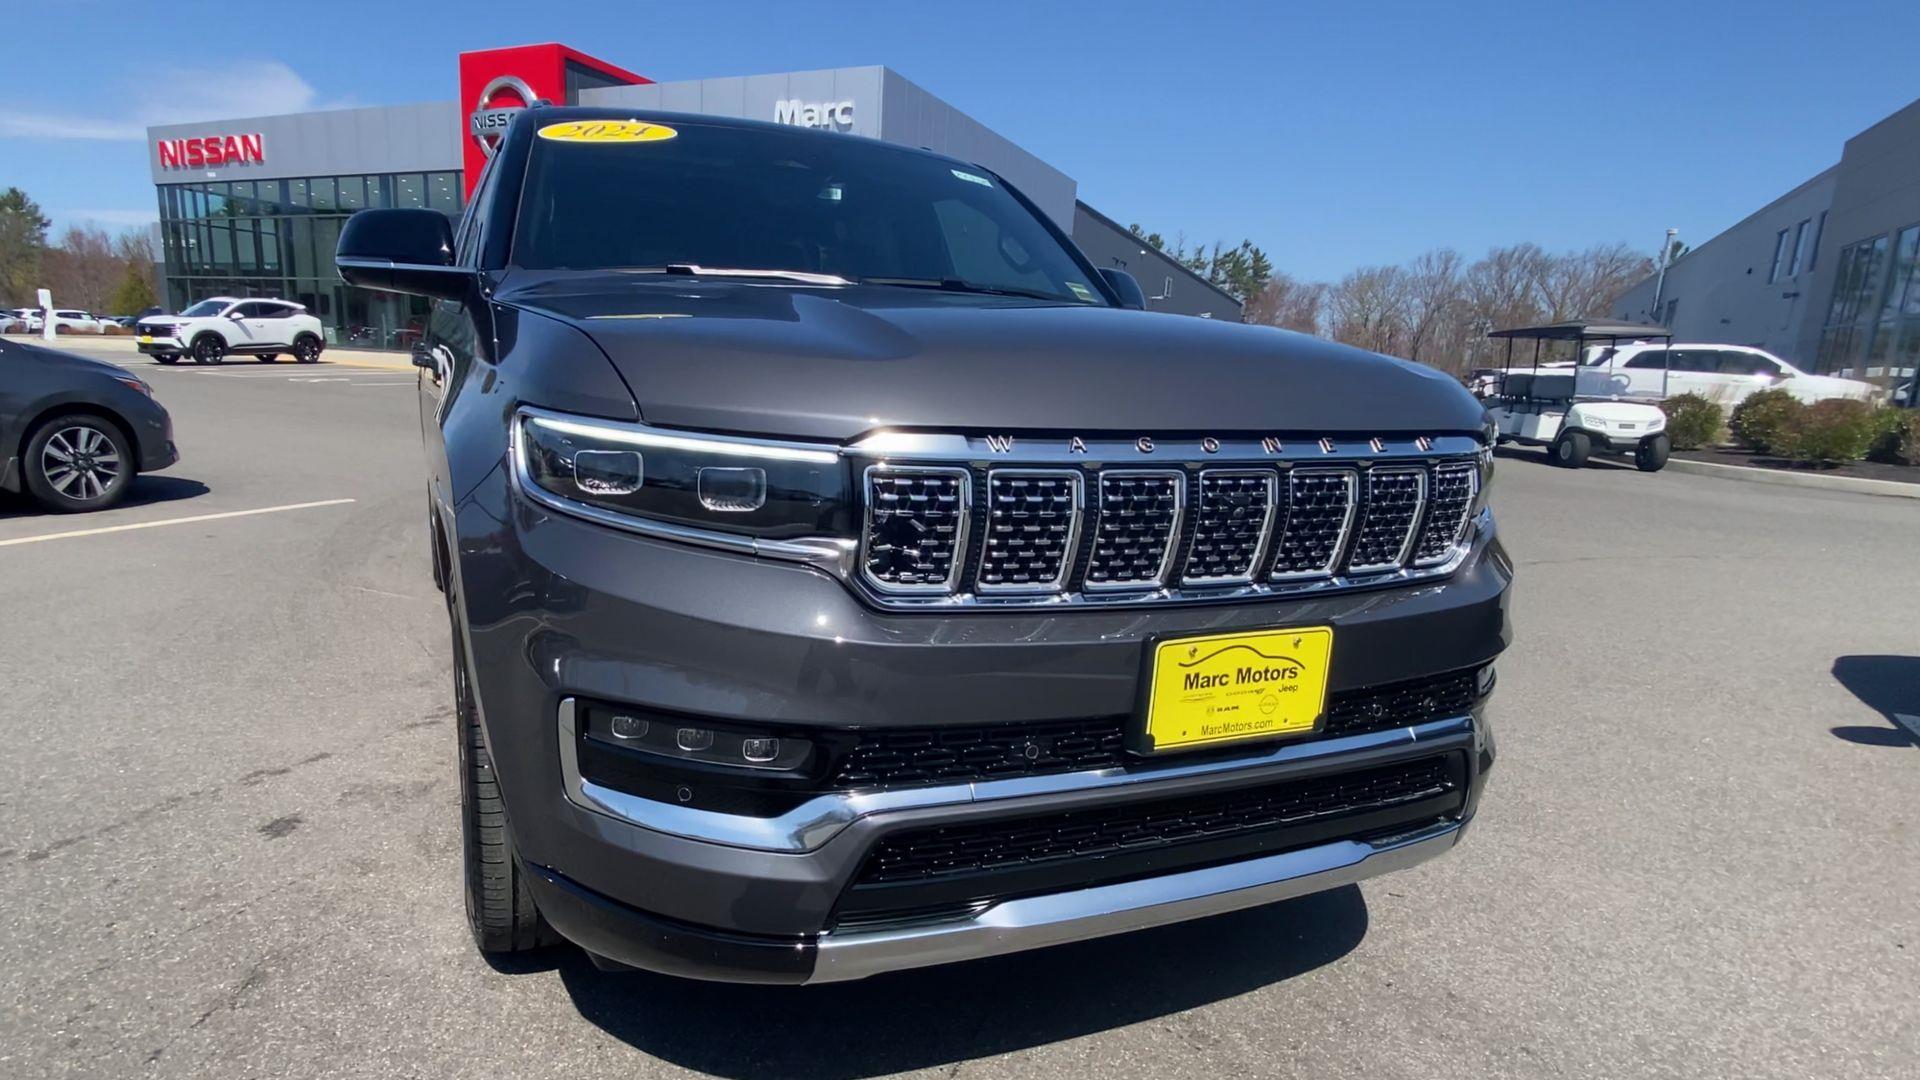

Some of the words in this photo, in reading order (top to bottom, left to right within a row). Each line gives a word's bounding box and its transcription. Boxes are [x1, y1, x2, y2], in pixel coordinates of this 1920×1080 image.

[474, 112, 516, 129] NISS
[774, 99, 854, 128] Marc
[559, 125, 651, 137] 2024
[158, 133, 264, 169] NISSAN
[985, 434, 1437, 455] WAGONEER
[1183, 671, 1230, 691] Marc
[1235, 666, 1299, 685] Motors
[1278, 684, 1298, 693] Jeep
[1200, 719, 1274, 736] MarcMotors.com
